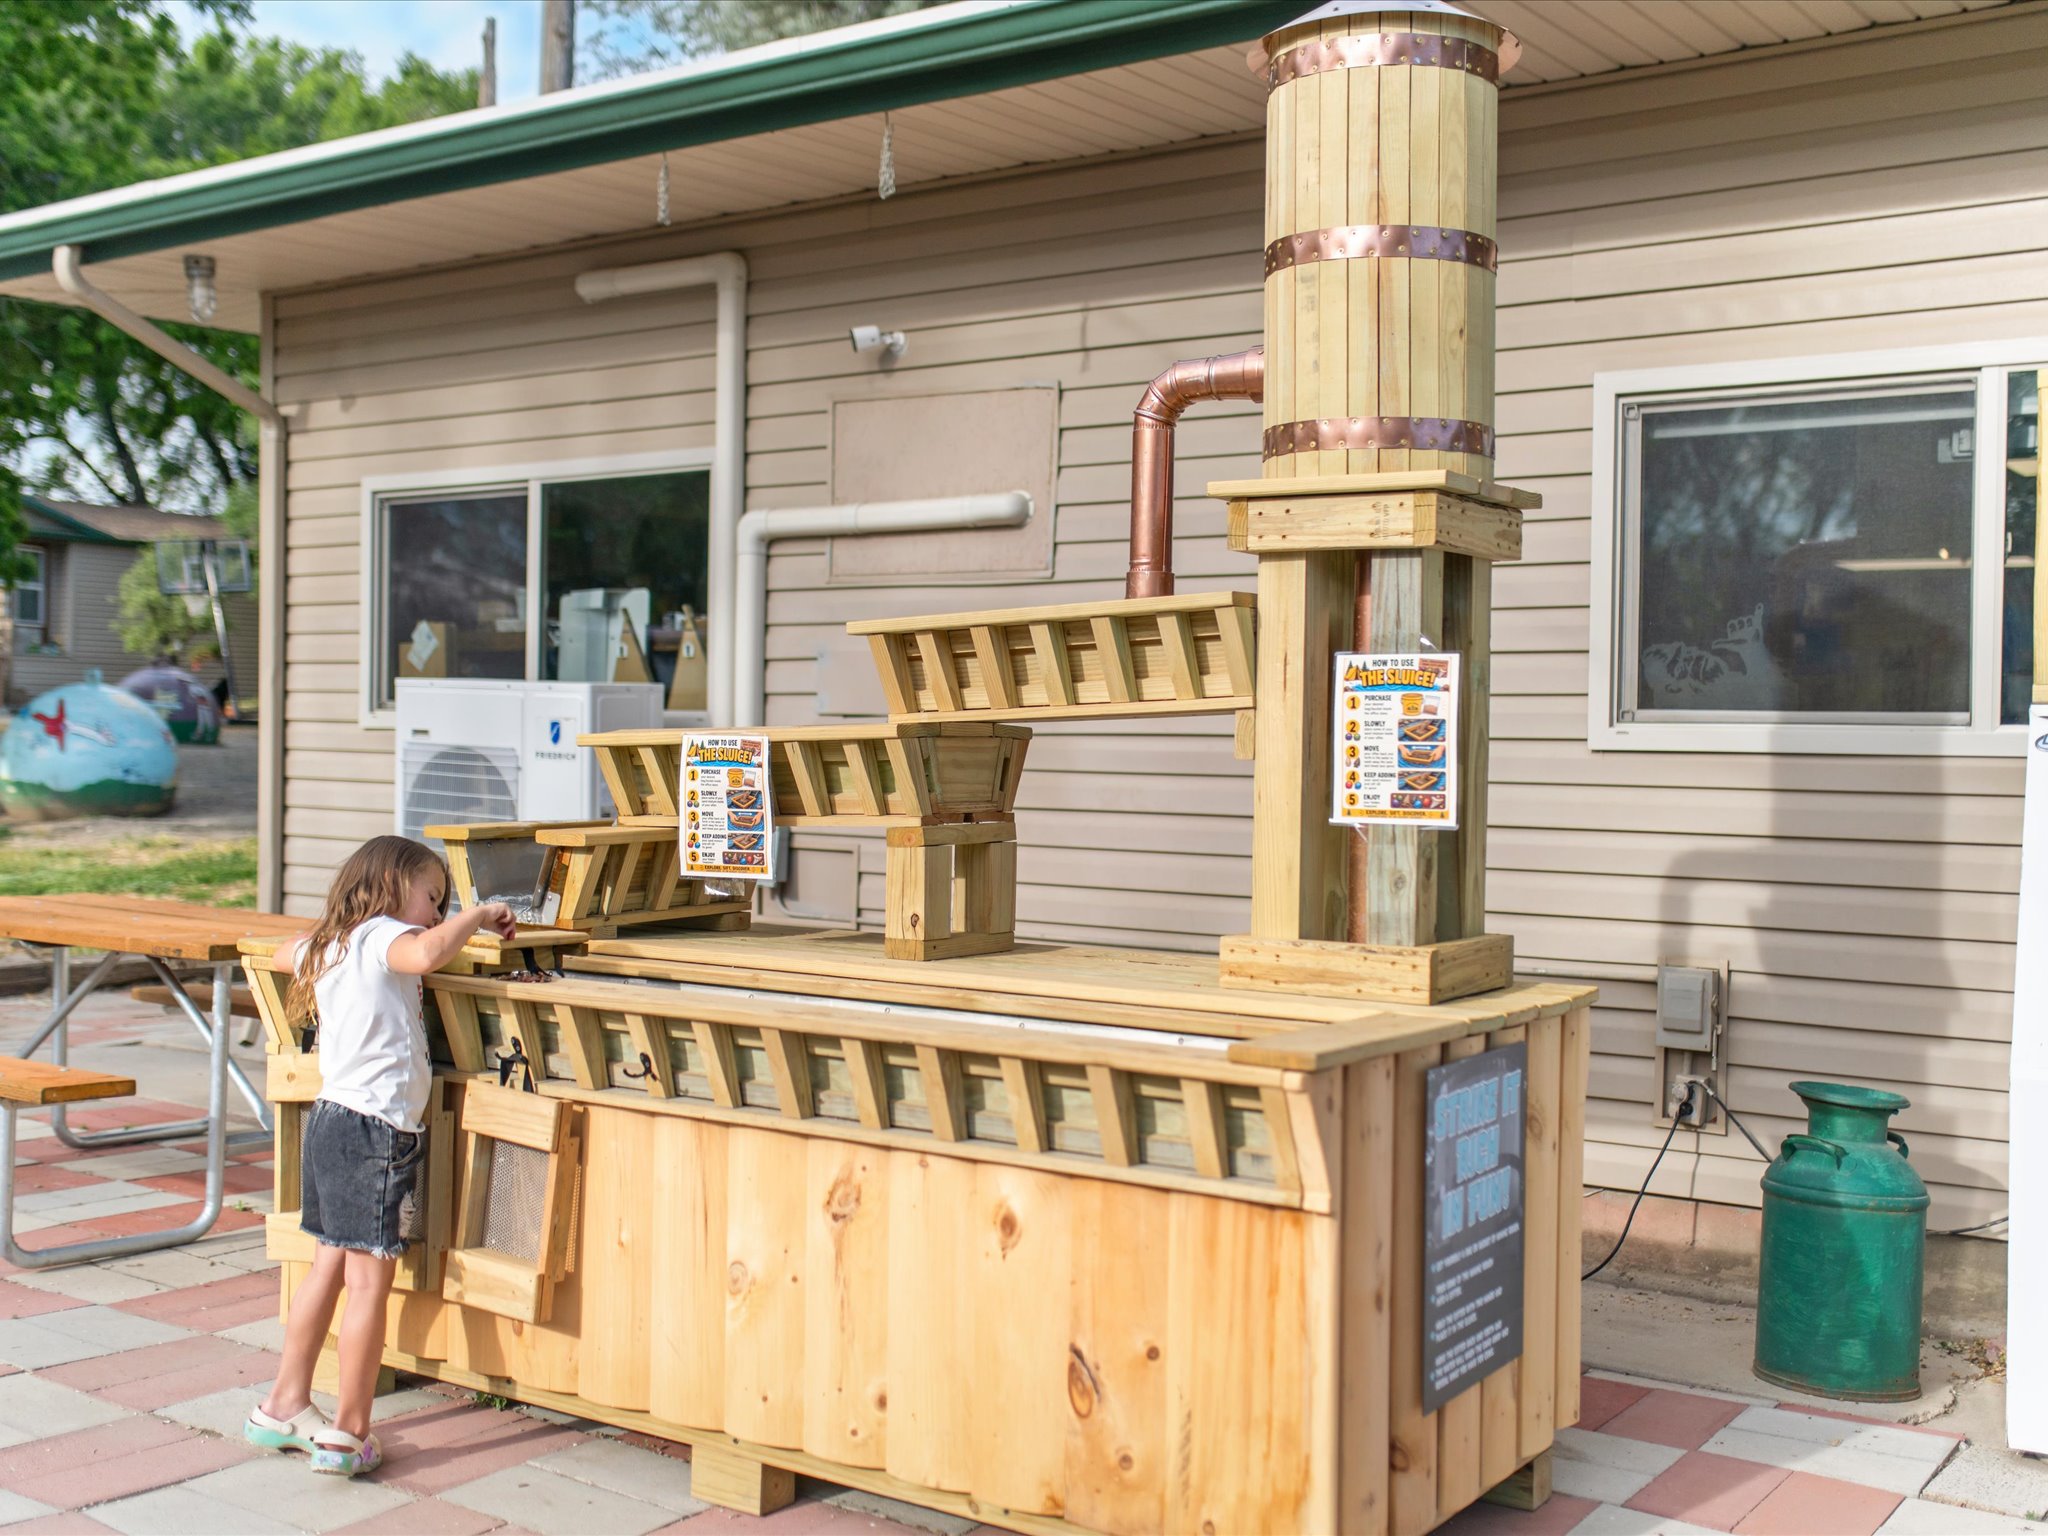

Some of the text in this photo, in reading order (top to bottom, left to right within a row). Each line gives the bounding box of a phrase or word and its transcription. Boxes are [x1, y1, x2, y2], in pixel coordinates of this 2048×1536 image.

[1372, 659, 1388, 667] HOW
[1390, 659, 1399, 667] TO
[1401, 659, 1414, 667] USE
[1359, 668, 1436, 688] THE SLUICE!
[1350, 697, 1357, 709] 1
[1349, 721, 1356, 732] 2
[535, 751, 576, 760] FRIEDRICH
[699, 747, 754, 764] THE SLUICE!
[1349, 746, 1356, 757] 3
[690, 770, 696, 781] 1
[1349, 771, 1356, 782] 4
[690, 790, 696, 800] 2
[1349, 794, 1356, 806] 5
[690, 812, 696, 821] 3
[690, 833, 696, 842] 4
[691, 852, 697, 861] 5
[1435, 1069, 1521, 1141] STRIKE IT
[1456, 1124, 1499, 1184] RICH
[1441, 1186, 1464, 1240] IN
